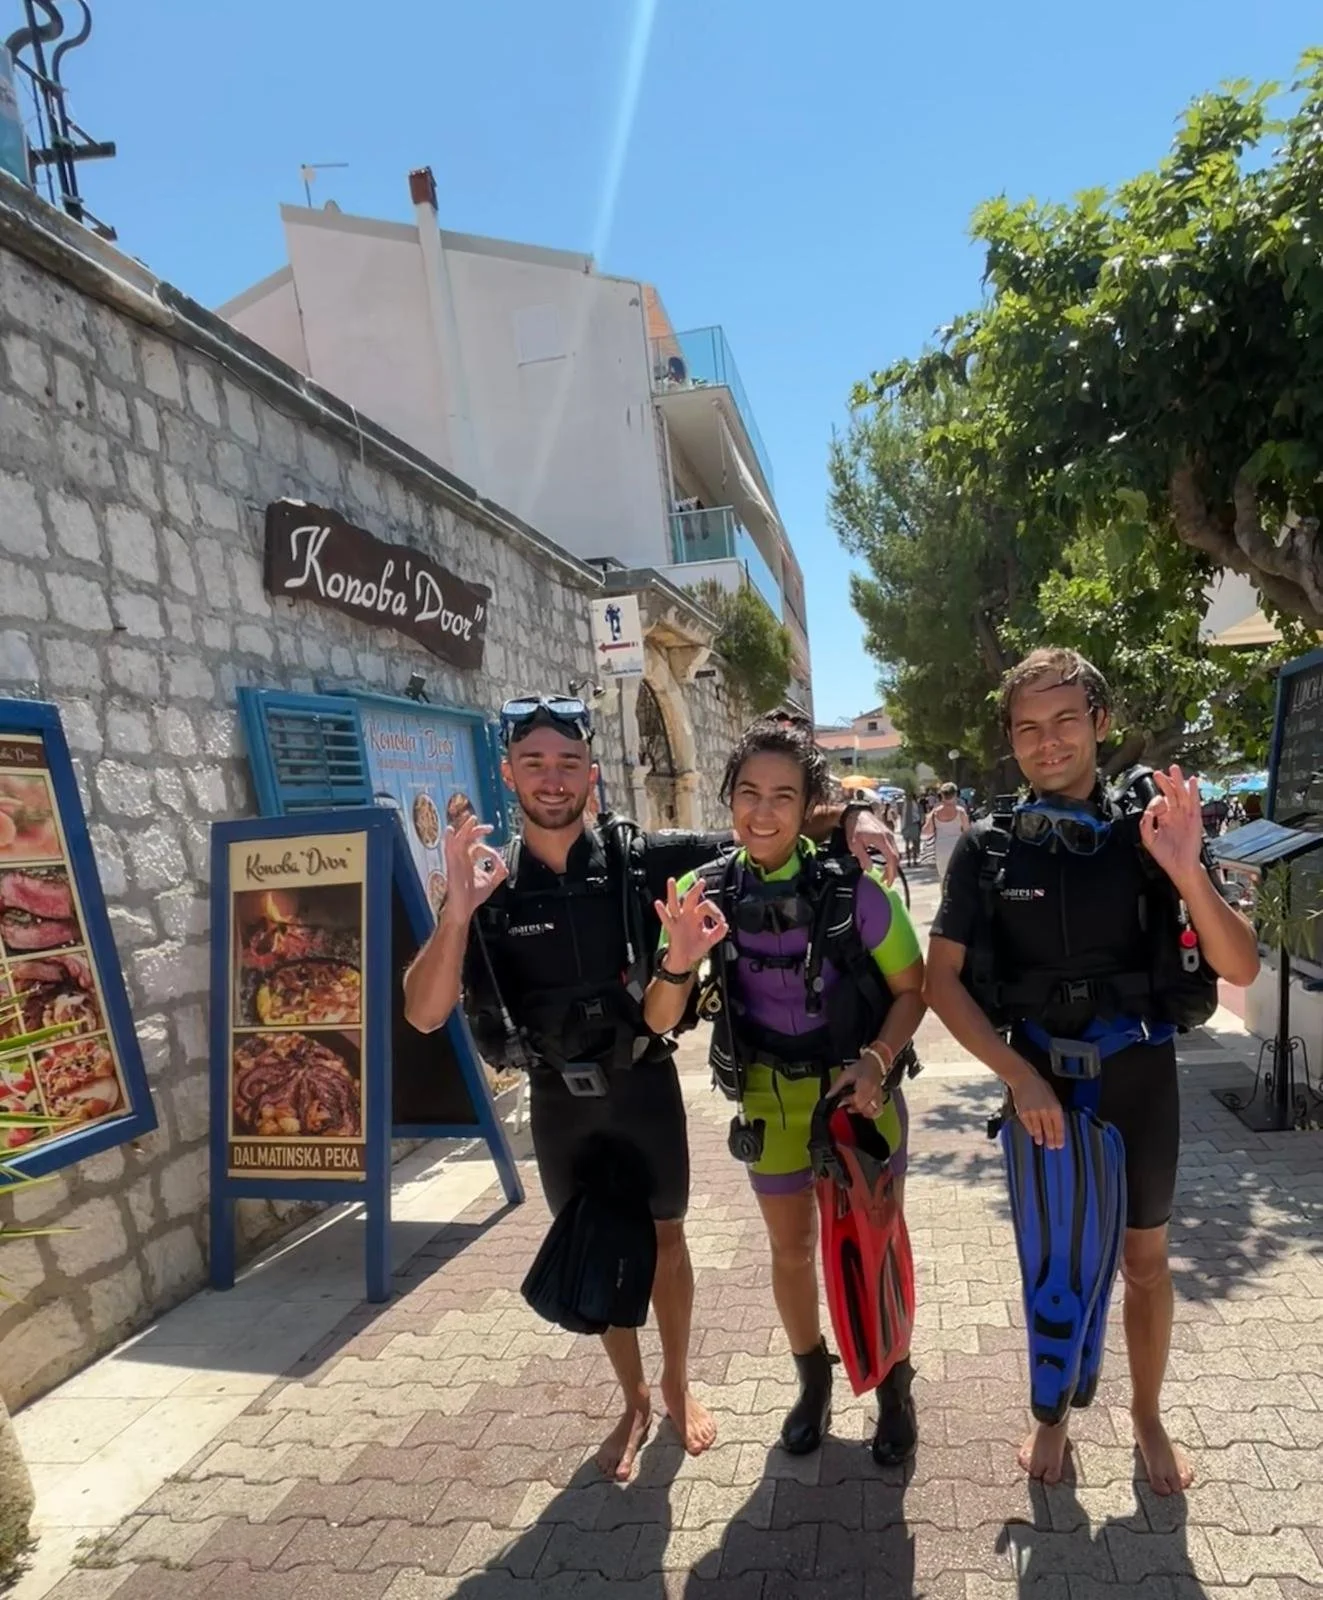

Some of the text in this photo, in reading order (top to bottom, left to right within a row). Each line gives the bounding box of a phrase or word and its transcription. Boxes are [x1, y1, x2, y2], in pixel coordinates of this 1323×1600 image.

[284, 525, 408, 617] Konoba
[245, 852, 301, 882] Konoba
[233, 1145, 360, 1168] DALMATINSKA PEKA
